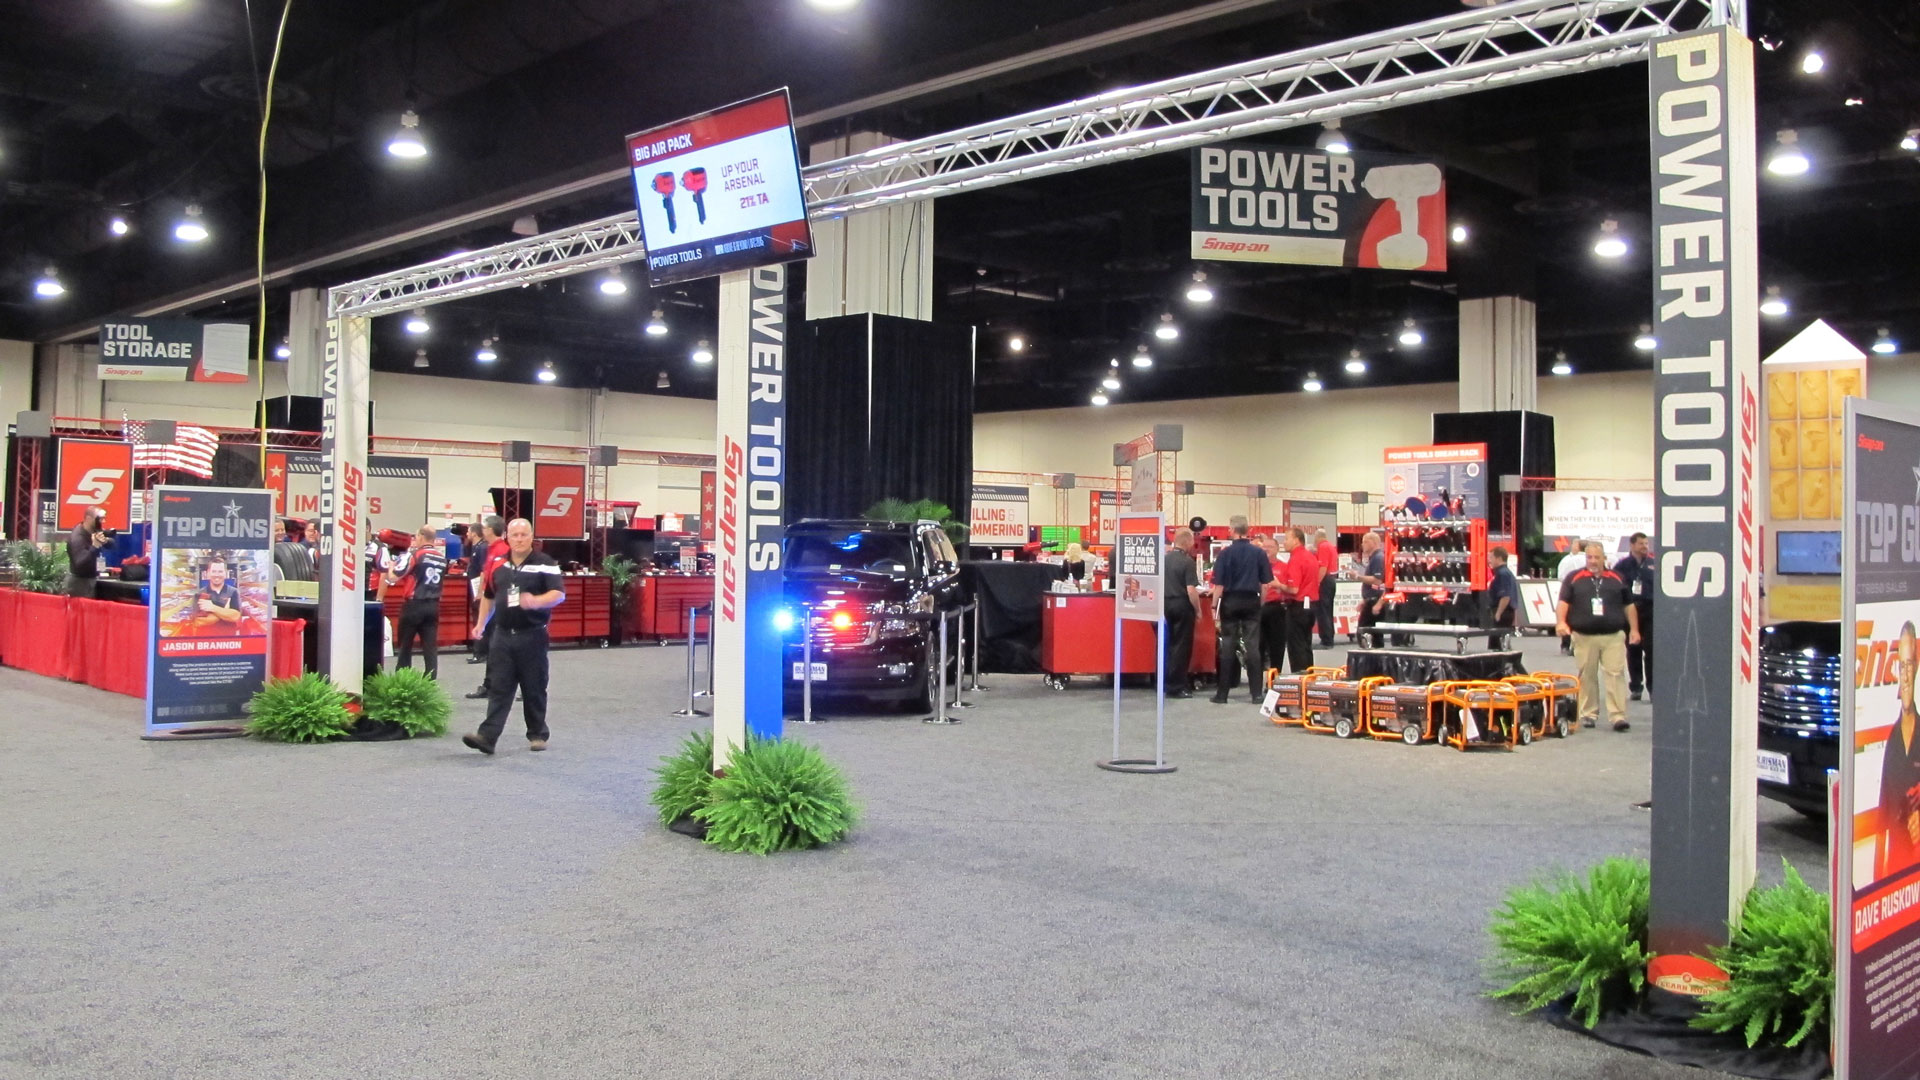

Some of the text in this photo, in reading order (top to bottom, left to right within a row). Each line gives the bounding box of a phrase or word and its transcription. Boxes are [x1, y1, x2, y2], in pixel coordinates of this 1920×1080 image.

[634, 133, 693, 162] BIG AIR PACK
[720, 158, 760, 178] UP YOUR
[1200, 147, 1356, 194] POWER
[724, 172, 766, 193] ARSENAL
[757, 193, 770, 205] TA
[1201, 187, 1338, 231] TOOLS
[1202, 237, 1270, 254] Snap-on
[653, 248, 703, 268] POWER TOOLS
[1656, 32, 1726, 598] POWER TOOLS
[105, 324, 153, 340] TOOL
[104, 341, 192, 358] STORAGE
[104, 368, 143, 376] Snap-on
[749, 263, 784, 571] OWER TOOLS
[320, 319, 338, 556] POWER TOOLS
[972, 508, 1005, 521] ILLING
[163, 517, 268, 538] TOP GUNS
[338, 461, 364, 592] Snap-on
[719, 434, 743, 623] Snap-on
[970, 523, 1023, 536] MMERING
[1738, 371, 1757, 685] Snap-on
[1856, 501, 1898, 563] TOP
[1124, 537, 1155, 546] BUY A
[1124, 546, 1155, 556] BIG PACK
[1124, 556, 1135, 564] AND
[1135, 557, 1146, 565] WIN
[1124, 564, 1155, 574] BIG POWER
[425, 567, 442, 584] 95
[163, 641, 242, 651] JASON BRANNON
[1855, 900, 1879, 935] DAVE
